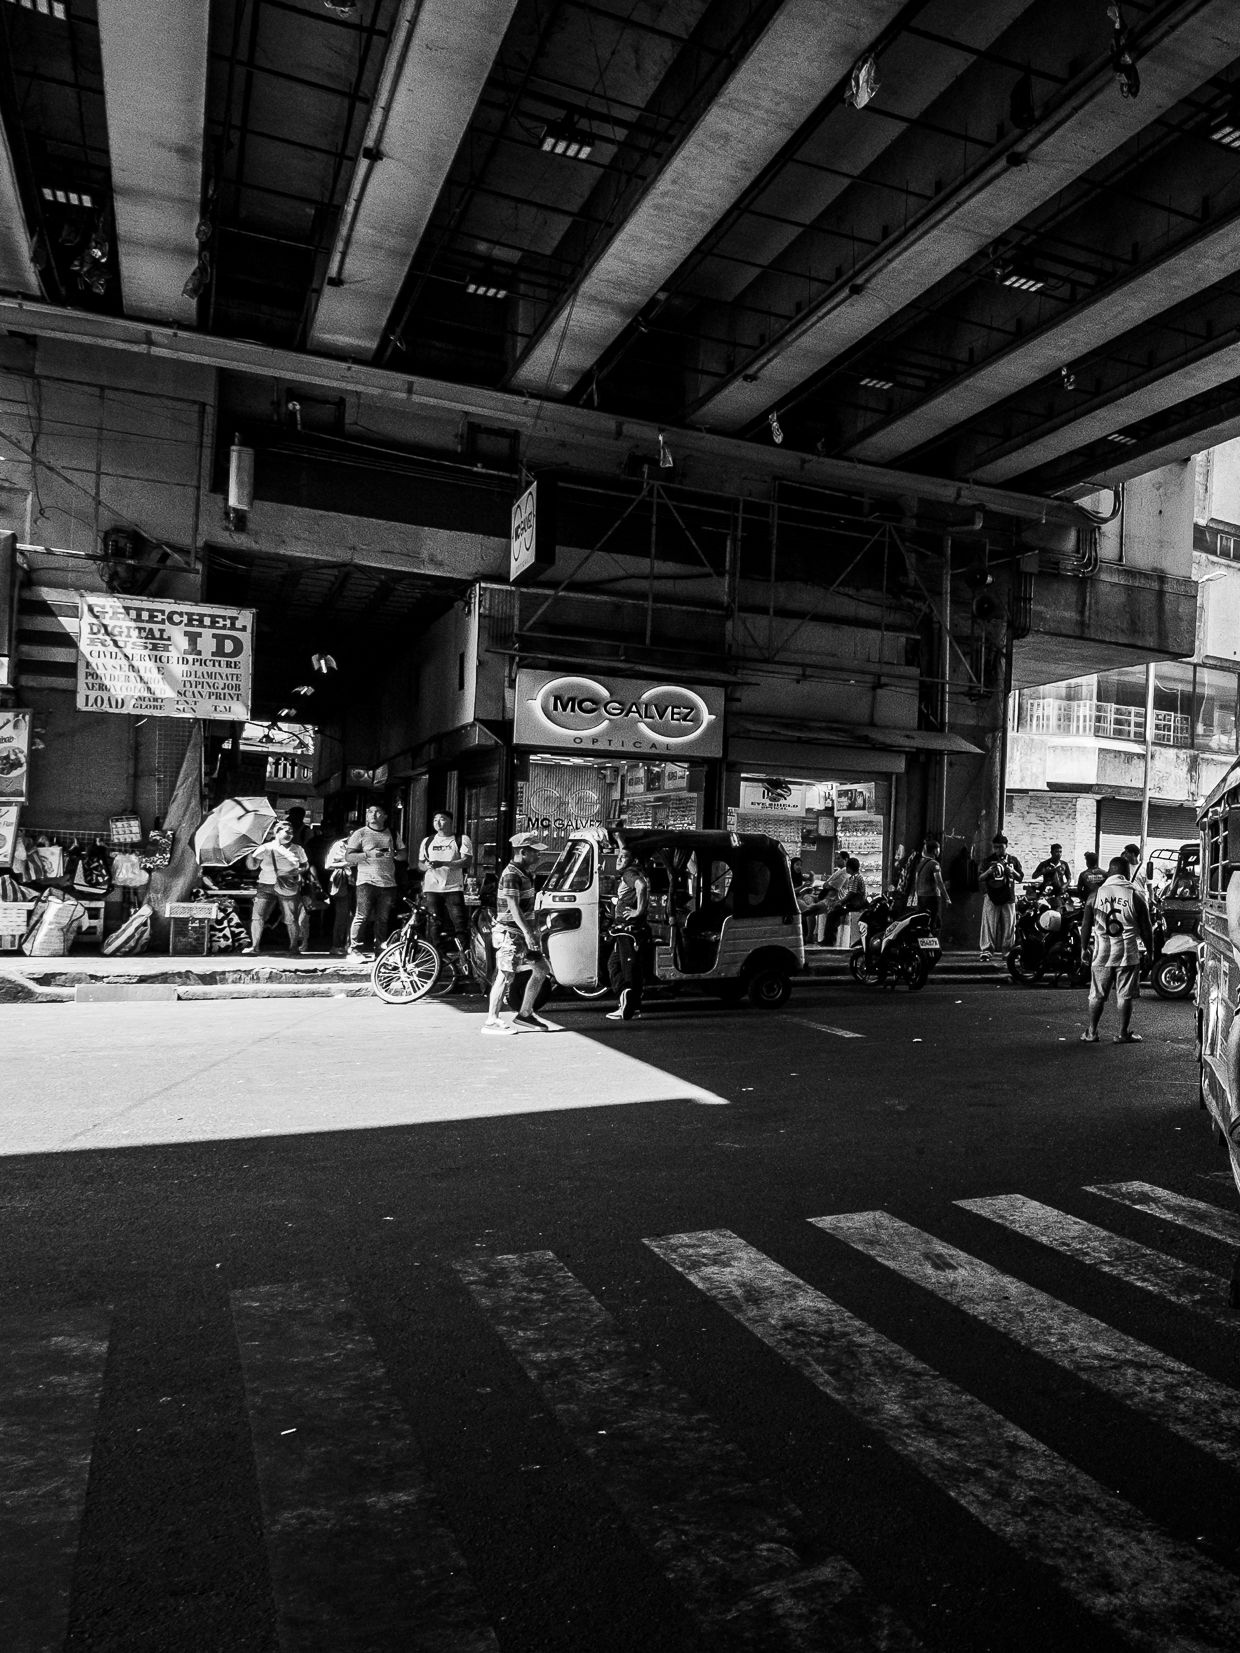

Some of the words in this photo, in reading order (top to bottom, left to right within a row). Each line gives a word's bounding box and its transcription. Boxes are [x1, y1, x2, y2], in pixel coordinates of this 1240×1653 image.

[87, 622, 172, 642] DIGITAL
[86, 637, 173, 653] RUSH
[183, 630, 244, 659] ID
[89, 650, 122, 661] CIVIL
[124, 651, 174, 665] SERVICE
[177, 656, 189, 666] ID
[192, 657, 242, 670] PICTURE
[111, 663, 165, 676] SERVICE
[181, 669, 192, 679] ID
[194, 670, 242, 682] LAMINATE
[181, 679, 219, 691] TYPING
[221, 682, 242, 692] JOB
[84, 694, 125, 710] LOAD
[177, 689, 242, 702] SCAN/PRINT
[133, 702, 166, 711] GLOBE
[175, 705, 198, 713] SUN
[552, 694, 599, 715] MC
[603, 699, 695, 724] GALVEZ
[572, 736, 674, 751] OPTICAL
[527, 817, 550, 829] MC
[554, 818, 602, 830] GALVEZ
[1100, 896, 1129, 907] JAMES
[1106, 908, 1124, 937] 6
